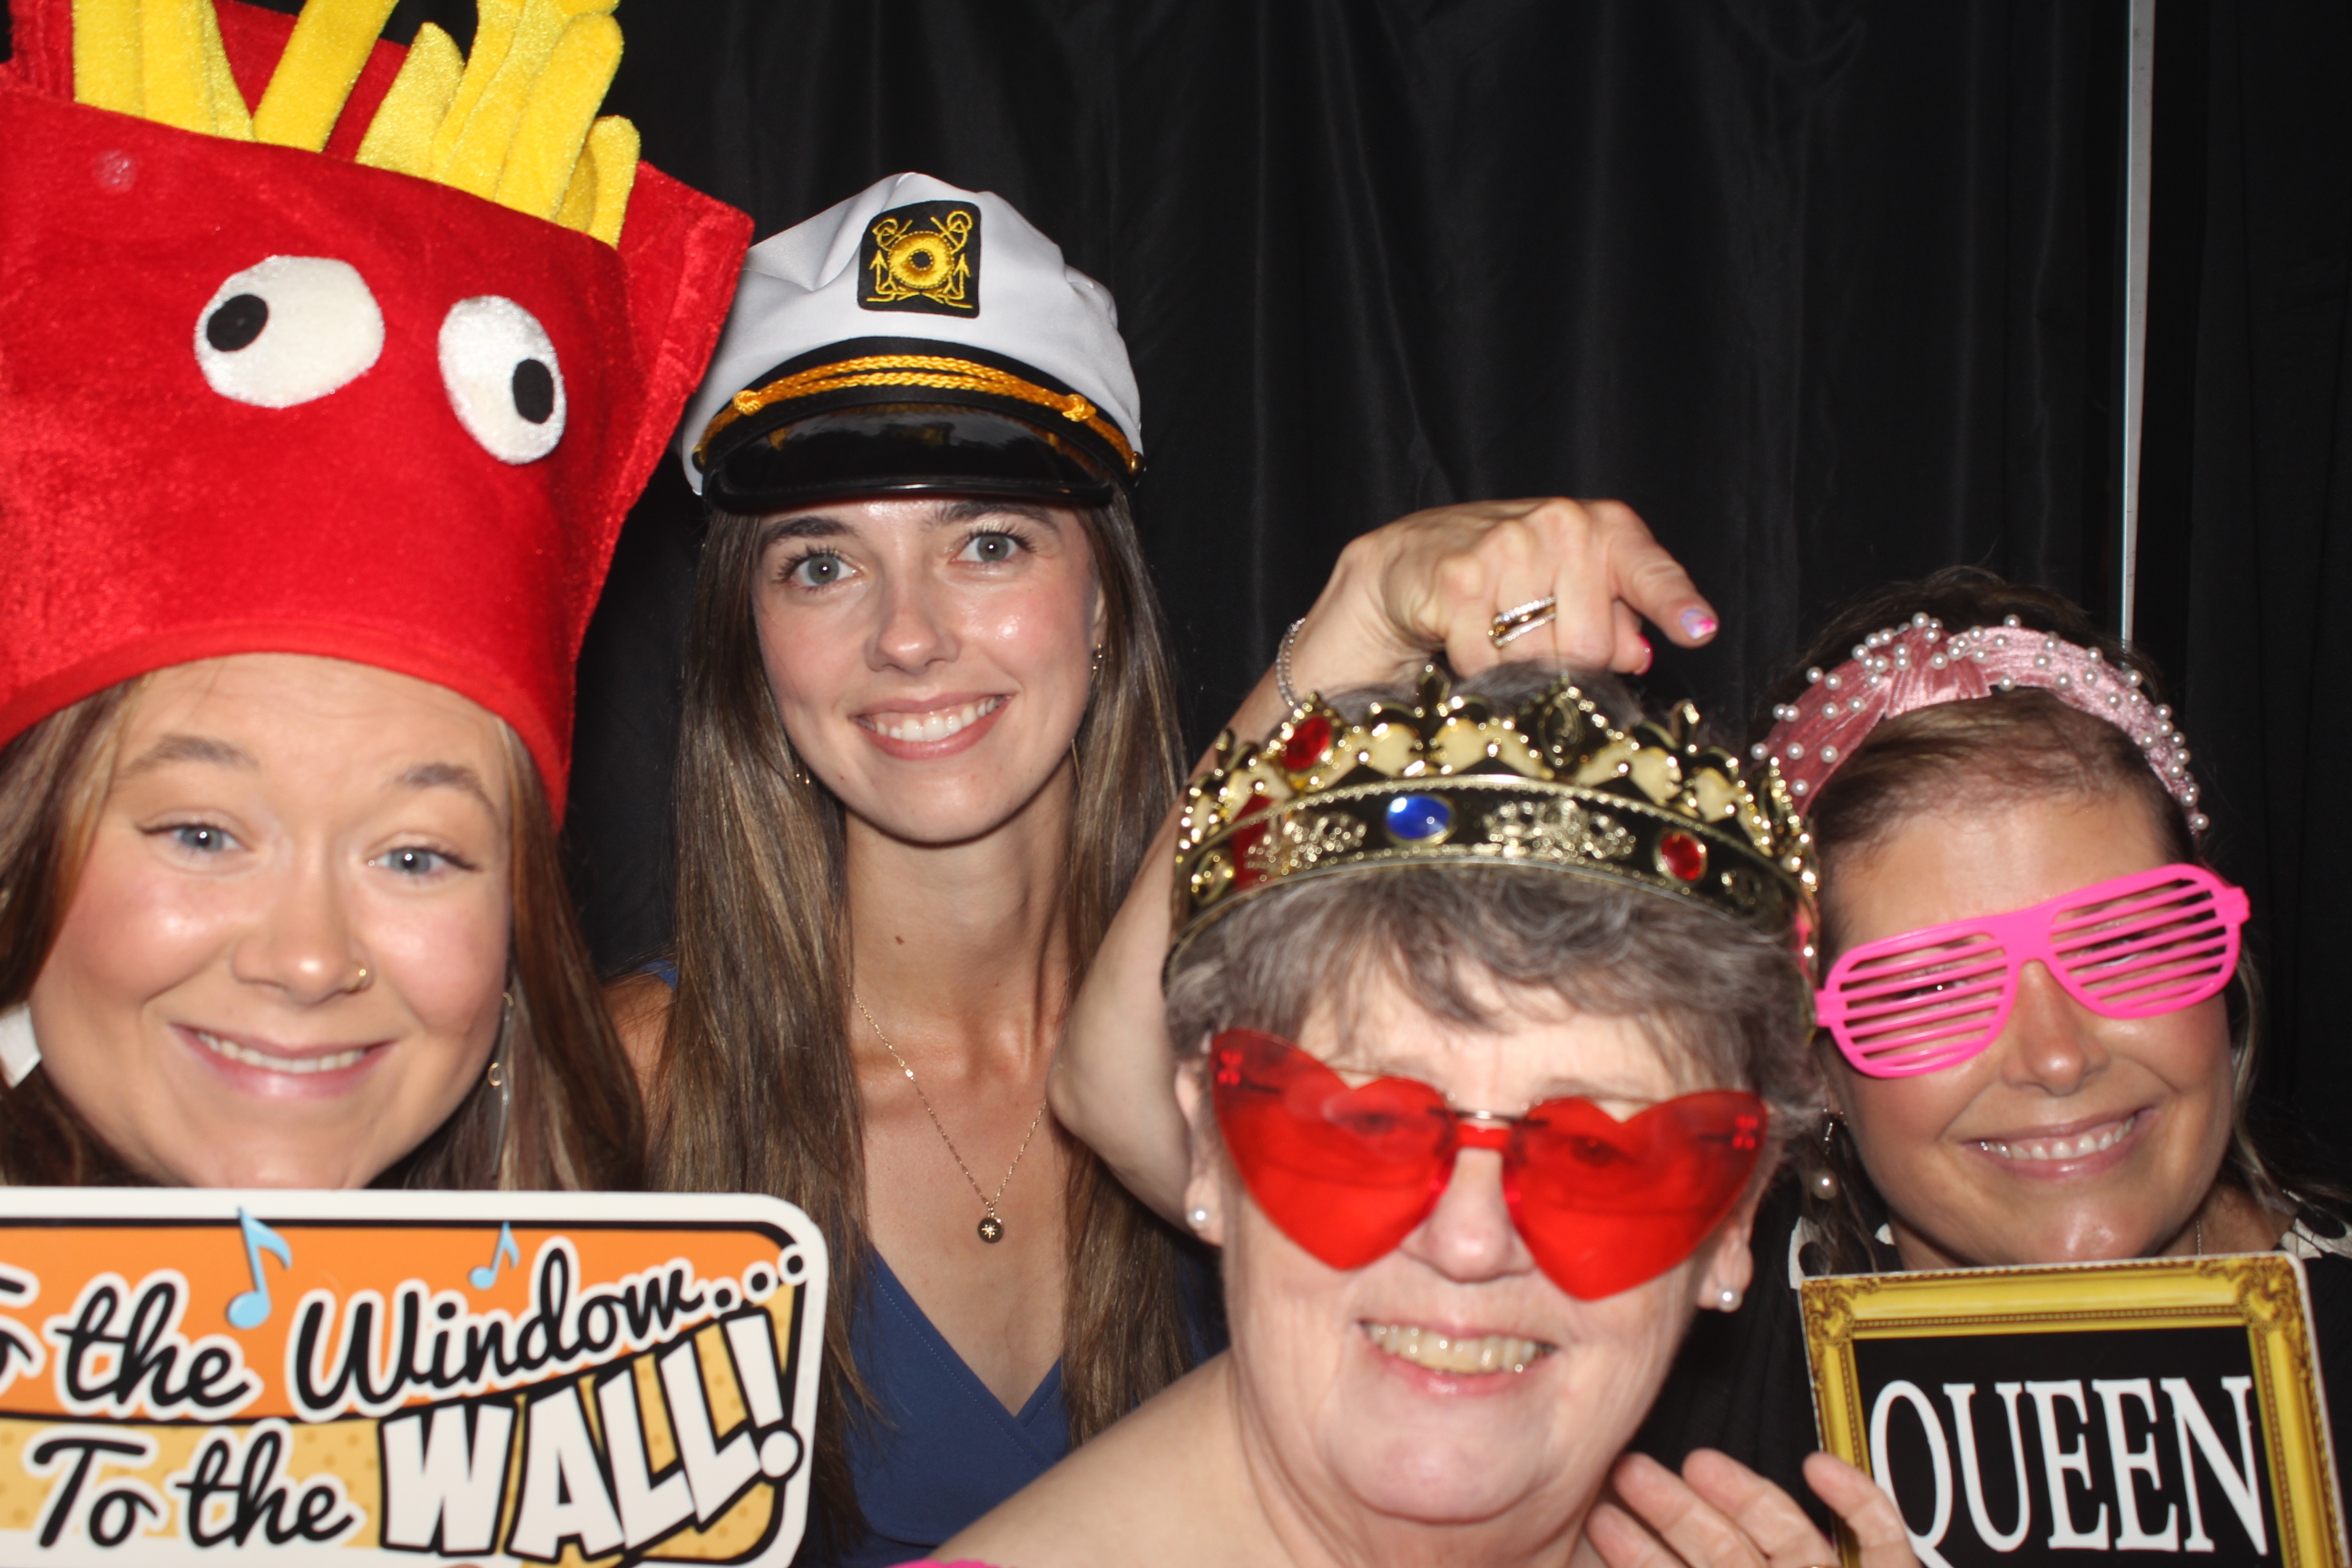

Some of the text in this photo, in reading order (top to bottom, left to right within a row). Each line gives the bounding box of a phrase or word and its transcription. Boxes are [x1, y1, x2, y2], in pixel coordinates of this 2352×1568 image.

[34, 1438, 159, 1548] To
[175, 1430, 354, 1548] the
[380, 1311, 804, 1560] WALL!
[54, 1282, 250, 1407] the
[1869, 1375, 2269, 1568] QUEEN
